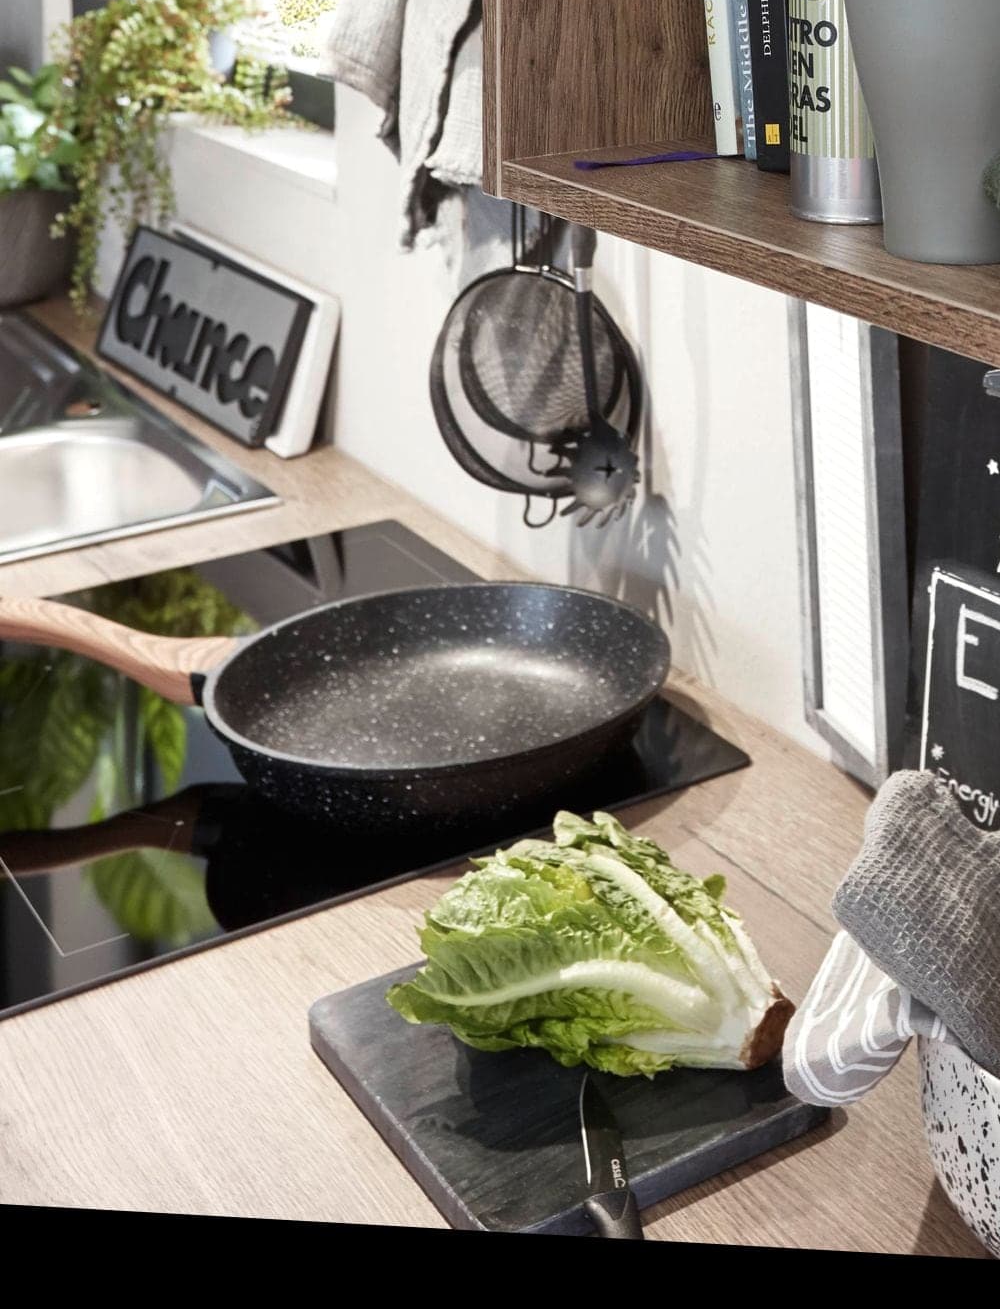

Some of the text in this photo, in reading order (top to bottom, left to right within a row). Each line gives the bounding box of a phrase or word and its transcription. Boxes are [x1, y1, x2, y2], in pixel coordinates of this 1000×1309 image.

[737, 3, 755, 92] Middle
[745, 99, 757, 148] The
[610, 1158, 623, 1179] casa
